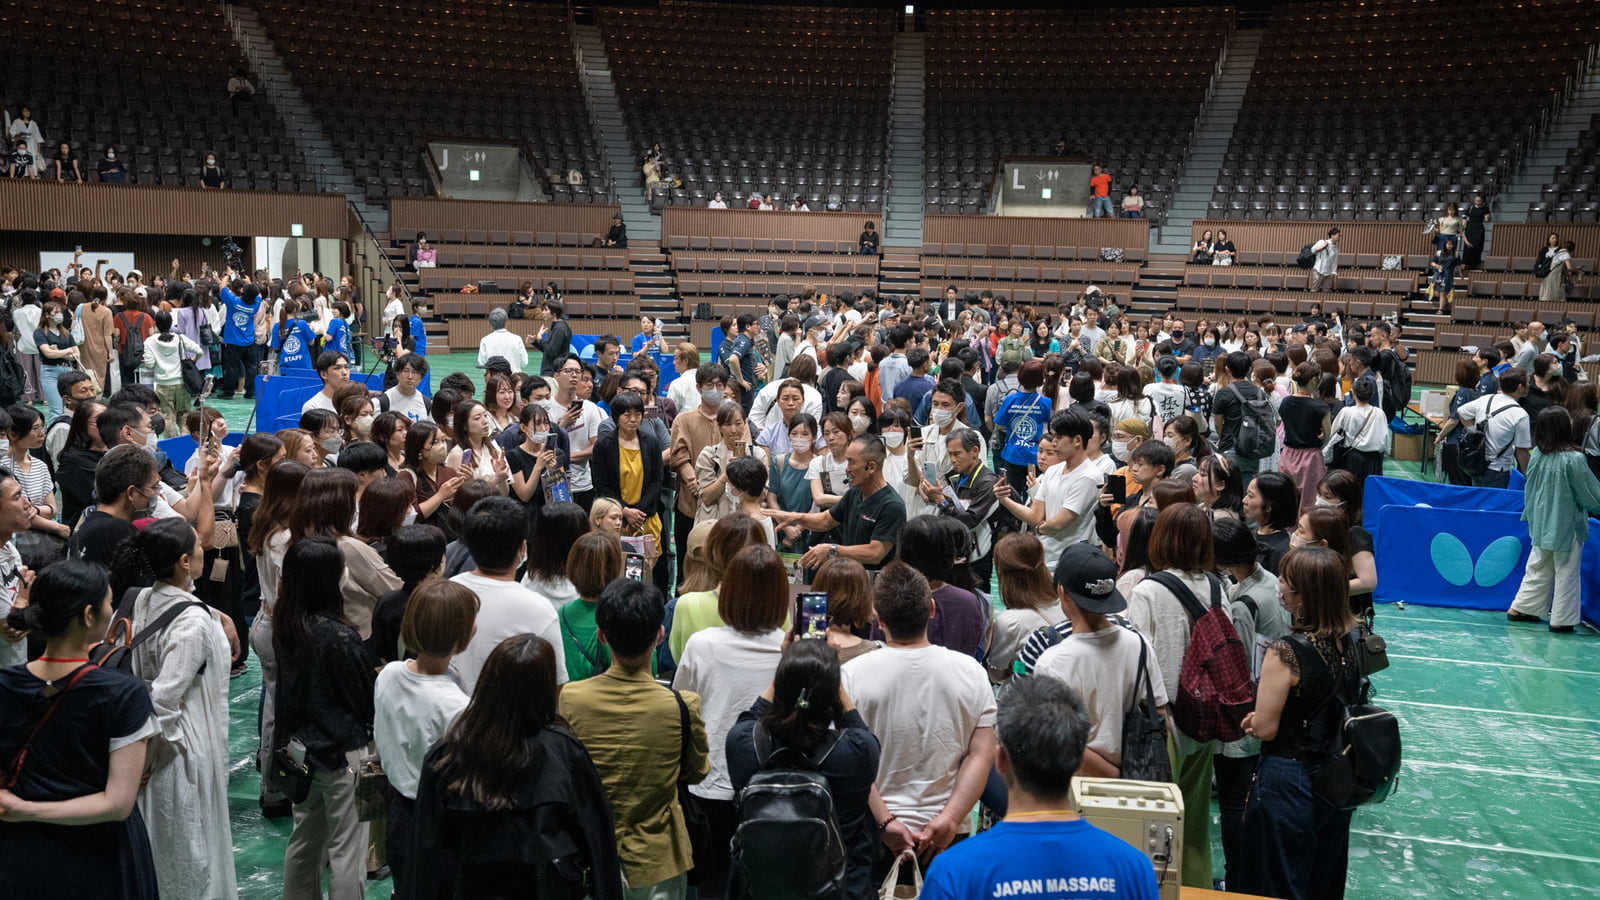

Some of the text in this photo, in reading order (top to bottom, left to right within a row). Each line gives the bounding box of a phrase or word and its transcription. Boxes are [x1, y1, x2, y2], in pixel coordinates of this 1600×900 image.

[438, 148, 449, 171] J
[1012, 168, 1026, 190] L
[992, 876, 1117, 898] JAPAN MASSAGE
